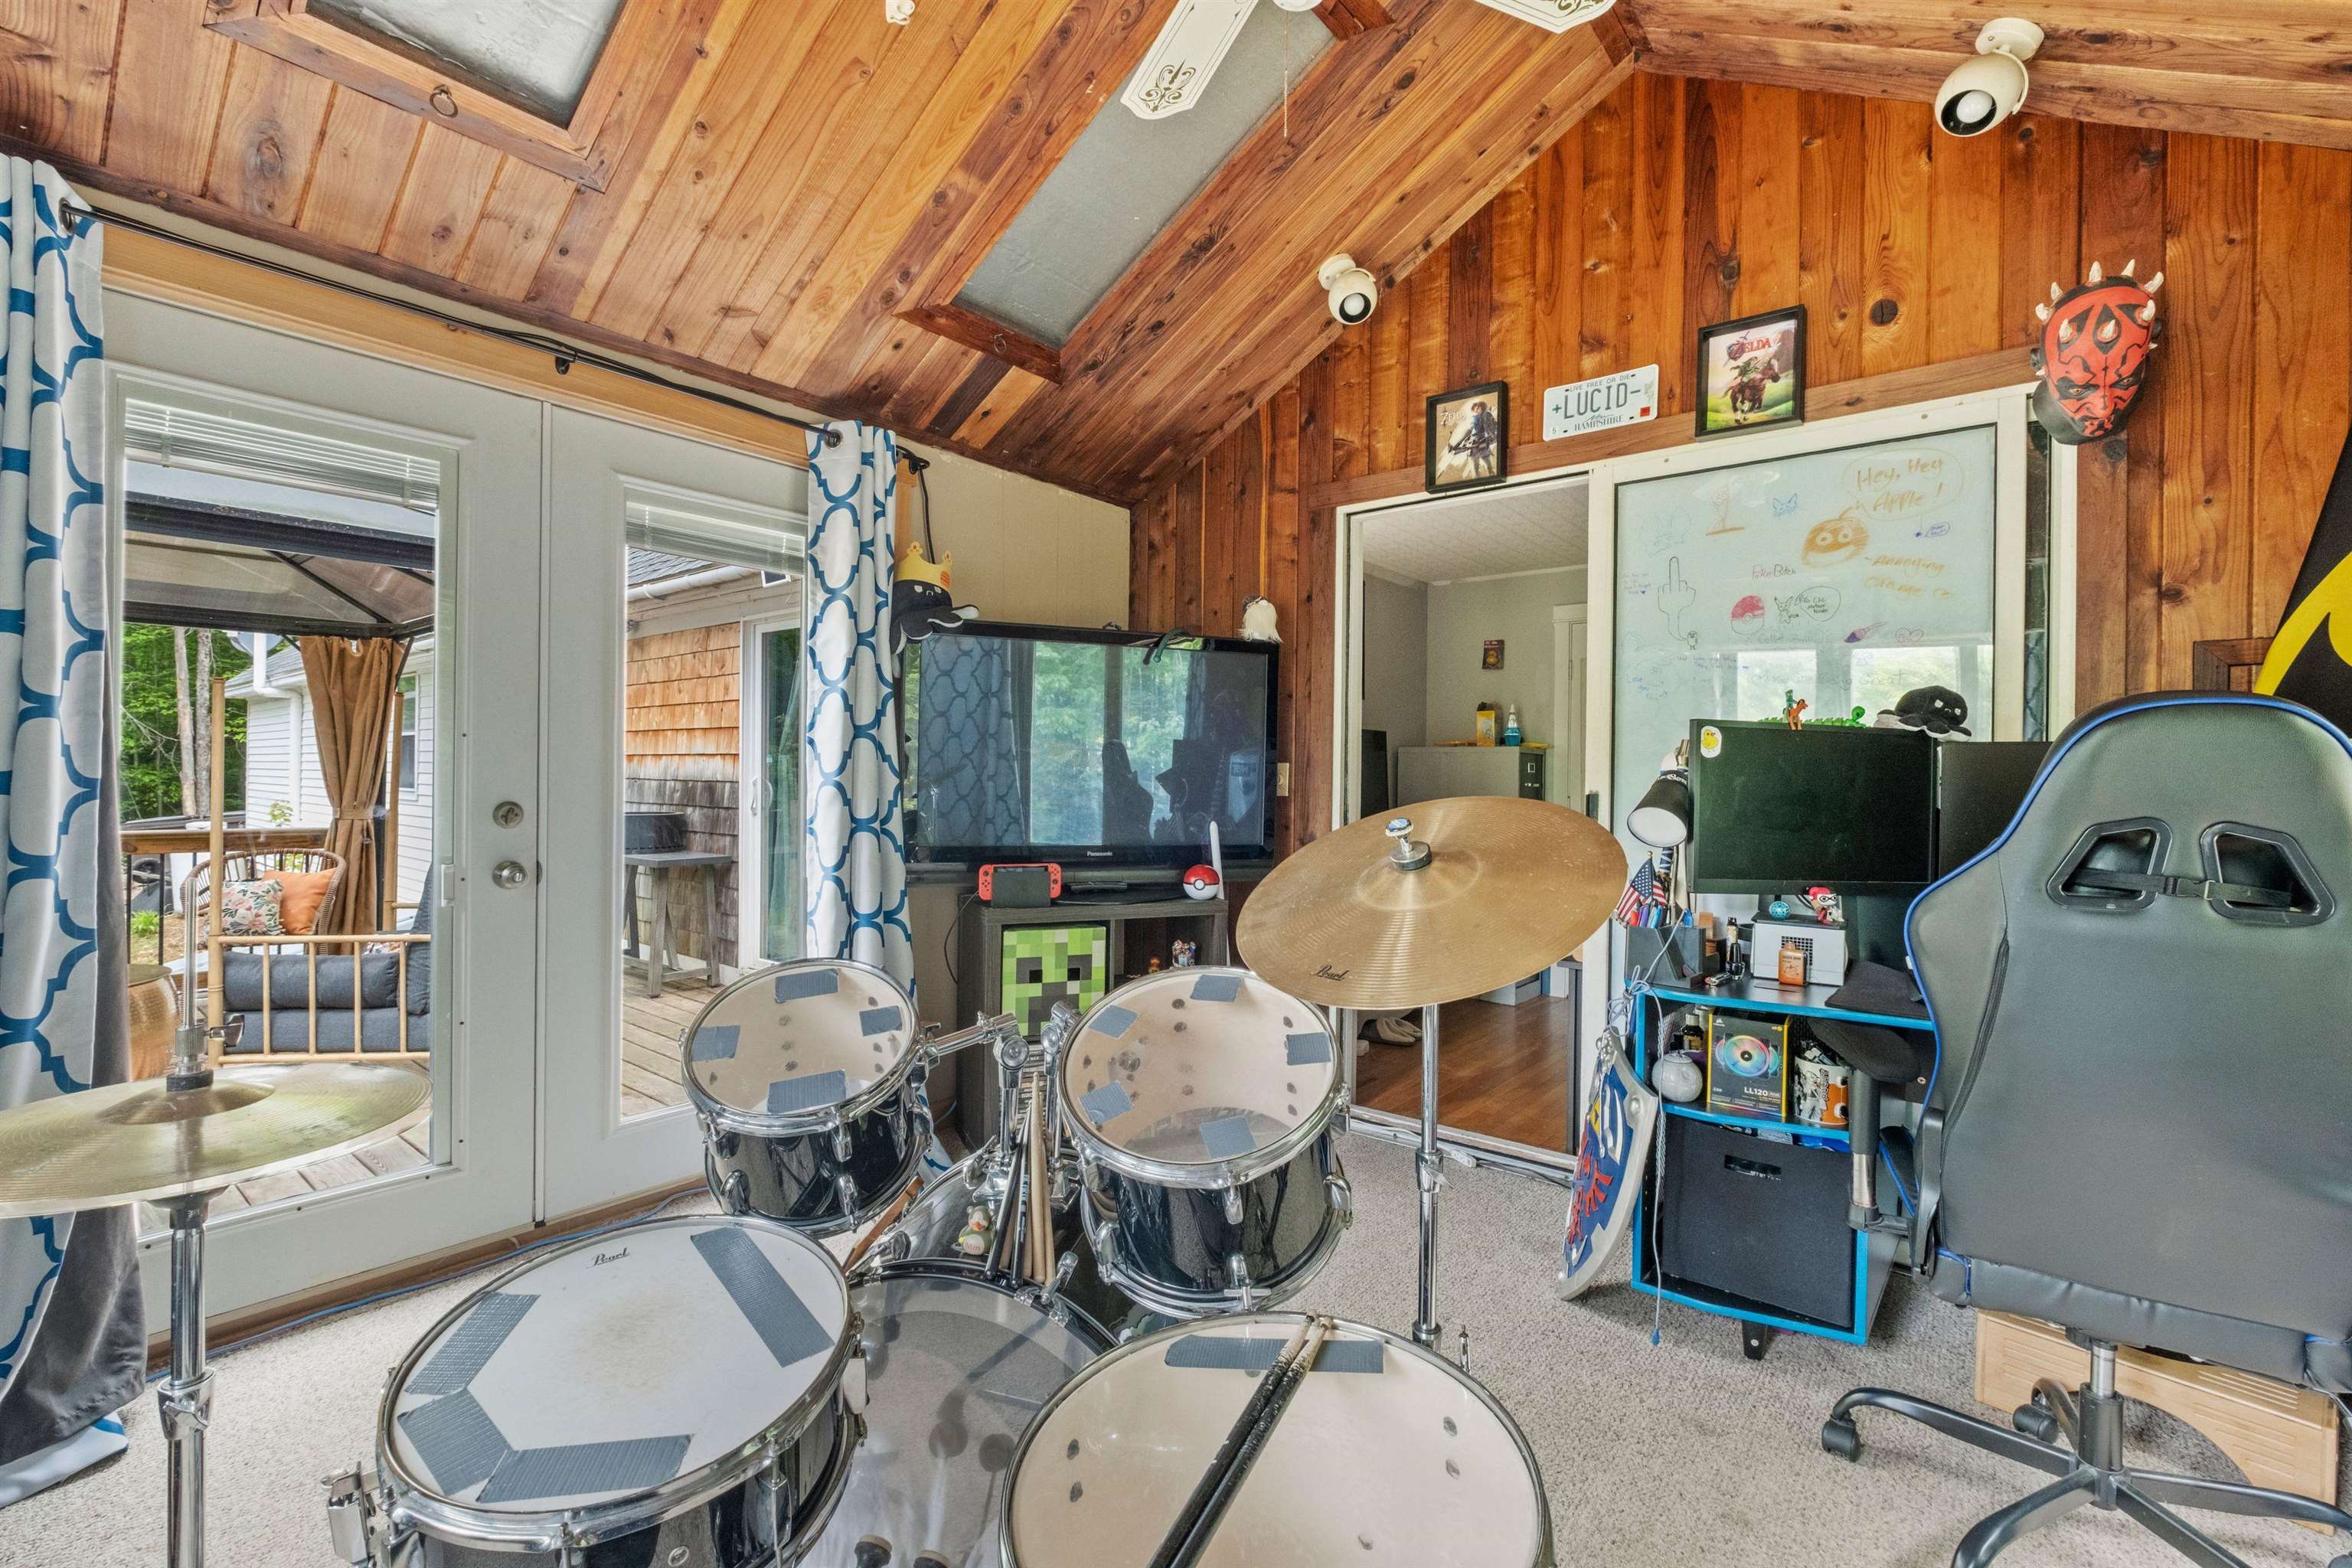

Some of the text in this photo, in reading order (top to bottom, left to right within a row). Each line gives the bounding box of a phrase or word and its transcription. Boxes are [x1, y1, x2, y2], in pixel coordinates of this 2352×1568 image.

[1727, 337, 1772, 361] ZELDA
[1570, 384, 1583, 393] LIVE
[1586, 379, 1603, 390] FREE
[1619, 373, 1630, 381] DIE
[1574, 415, 1624, 431] HAMPSHIRE
[1310, 965, 1349, 981] Pearl
[1744, 1086, 1769, 1096] LL120
[586, 1247, 629, 1268] Pearl
